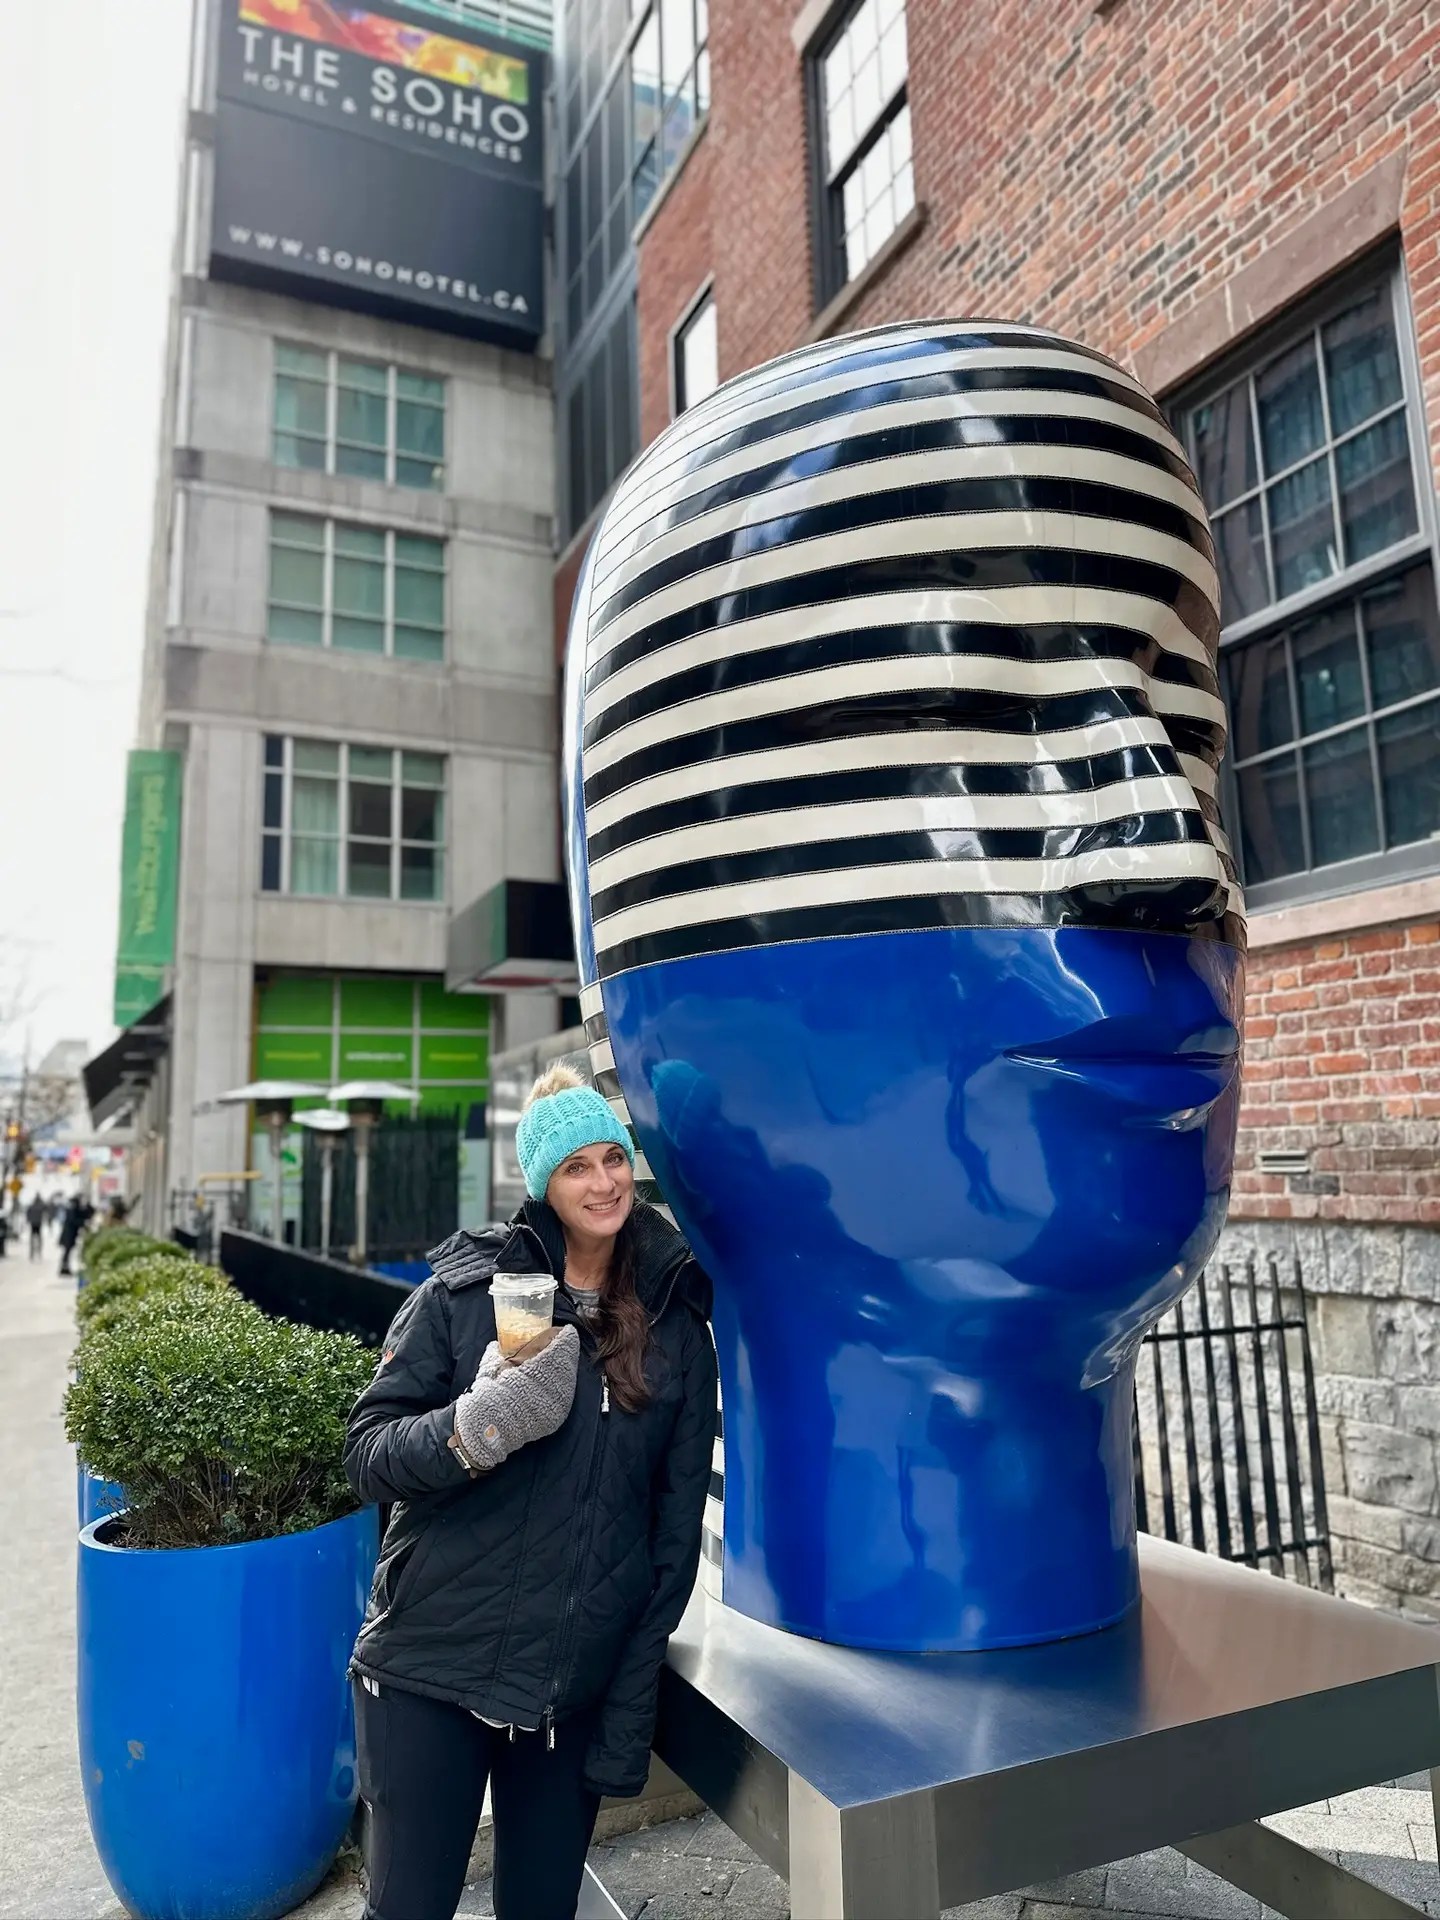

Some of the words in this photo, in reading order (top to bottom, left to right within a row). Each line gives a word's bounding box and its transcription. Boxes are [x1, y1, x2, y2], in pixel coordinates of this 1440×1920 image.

[237, 25, 340, 88] THE
[371, 66, 529, 142] SOHO
[243, 69, 328, 107] HOTEL
[342, 97, 357, 114] &
[370, 105, 522, 163] RESIDENCES
[229, 225, 528, 313] WWW.SOHOHOTEL.CA
